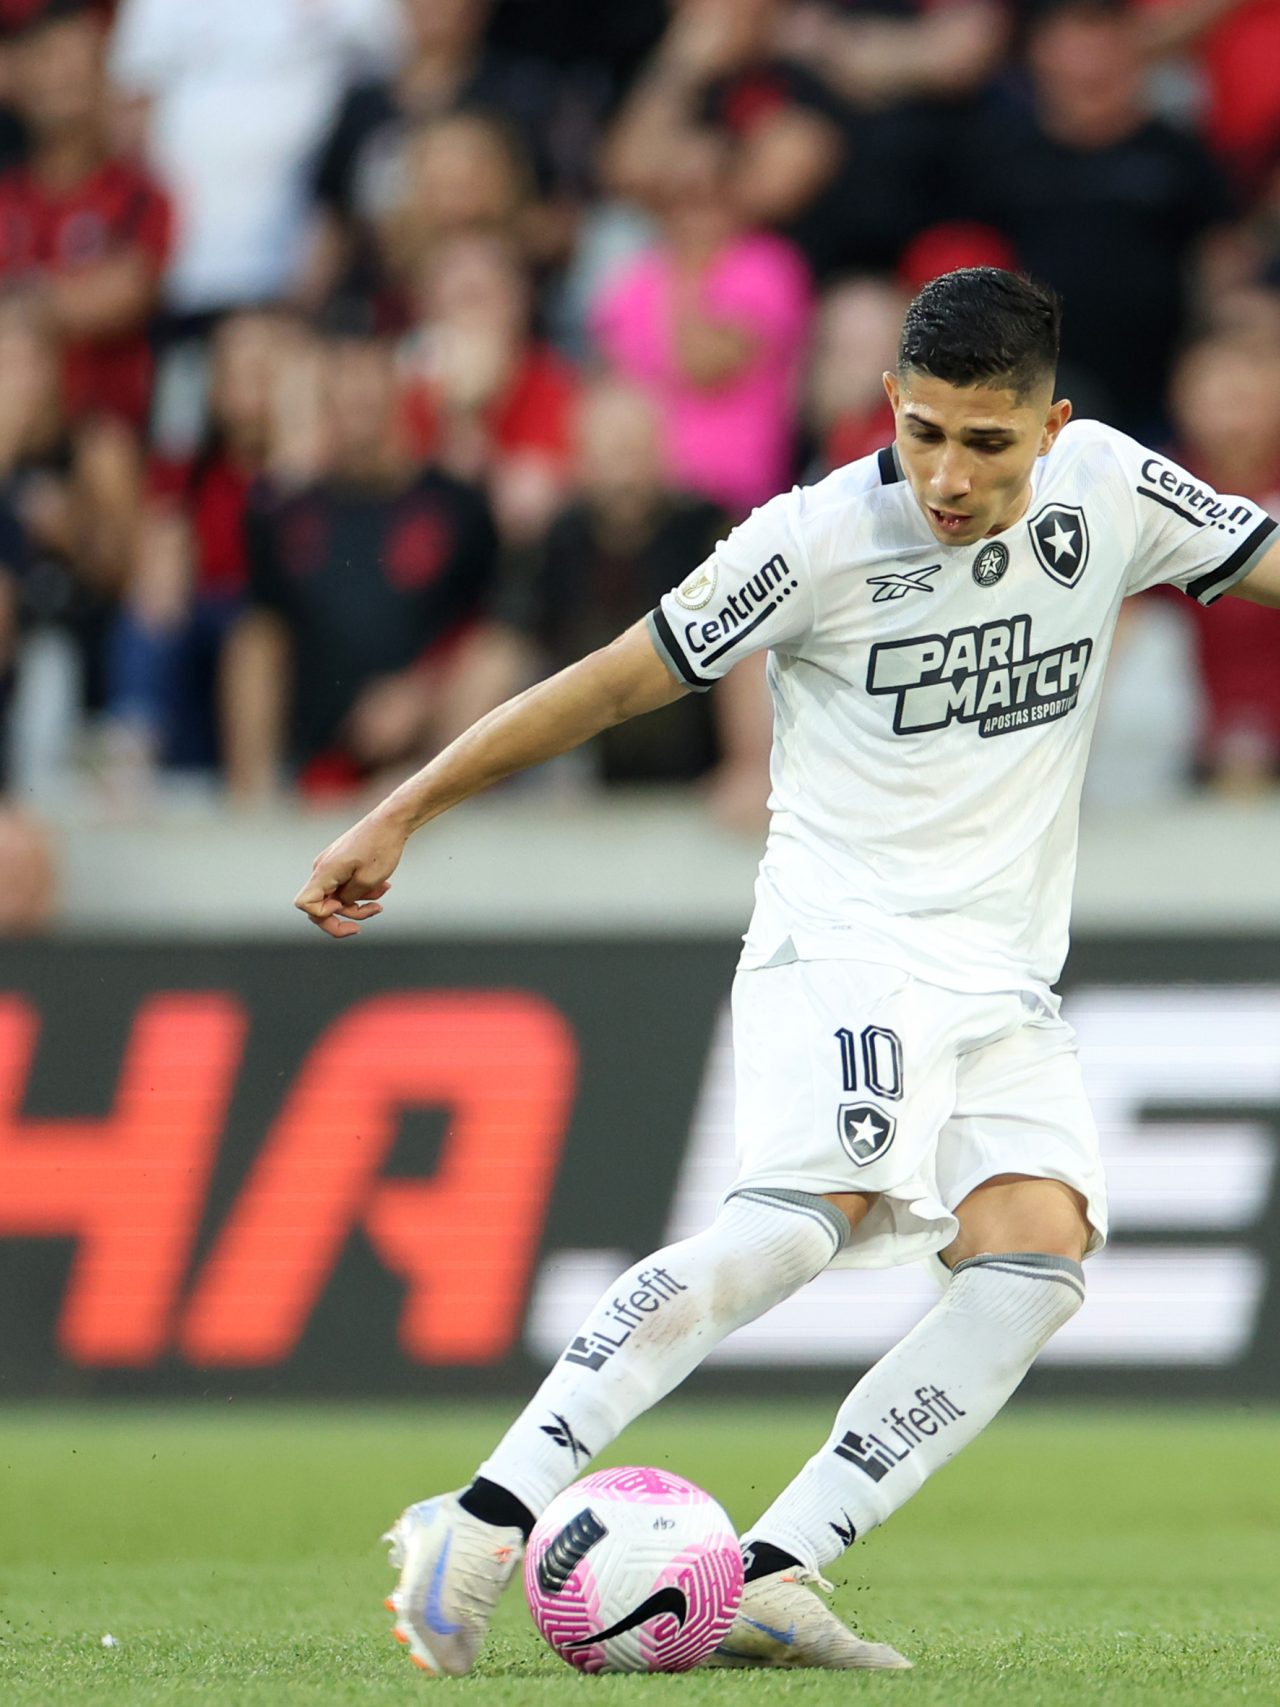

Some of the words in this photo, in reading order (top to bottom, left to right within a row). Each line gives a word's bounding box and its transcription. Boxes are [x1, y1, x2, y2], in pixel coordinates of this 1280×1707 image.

[684, 553, 790, 654] Centrum
[872, 620, 1027, 690] PARI
[899, 644, 1089, 730] MATCH
[983, 707, 1030, 733] APOSTAS
[834, 1024, 904, 1102] 10
